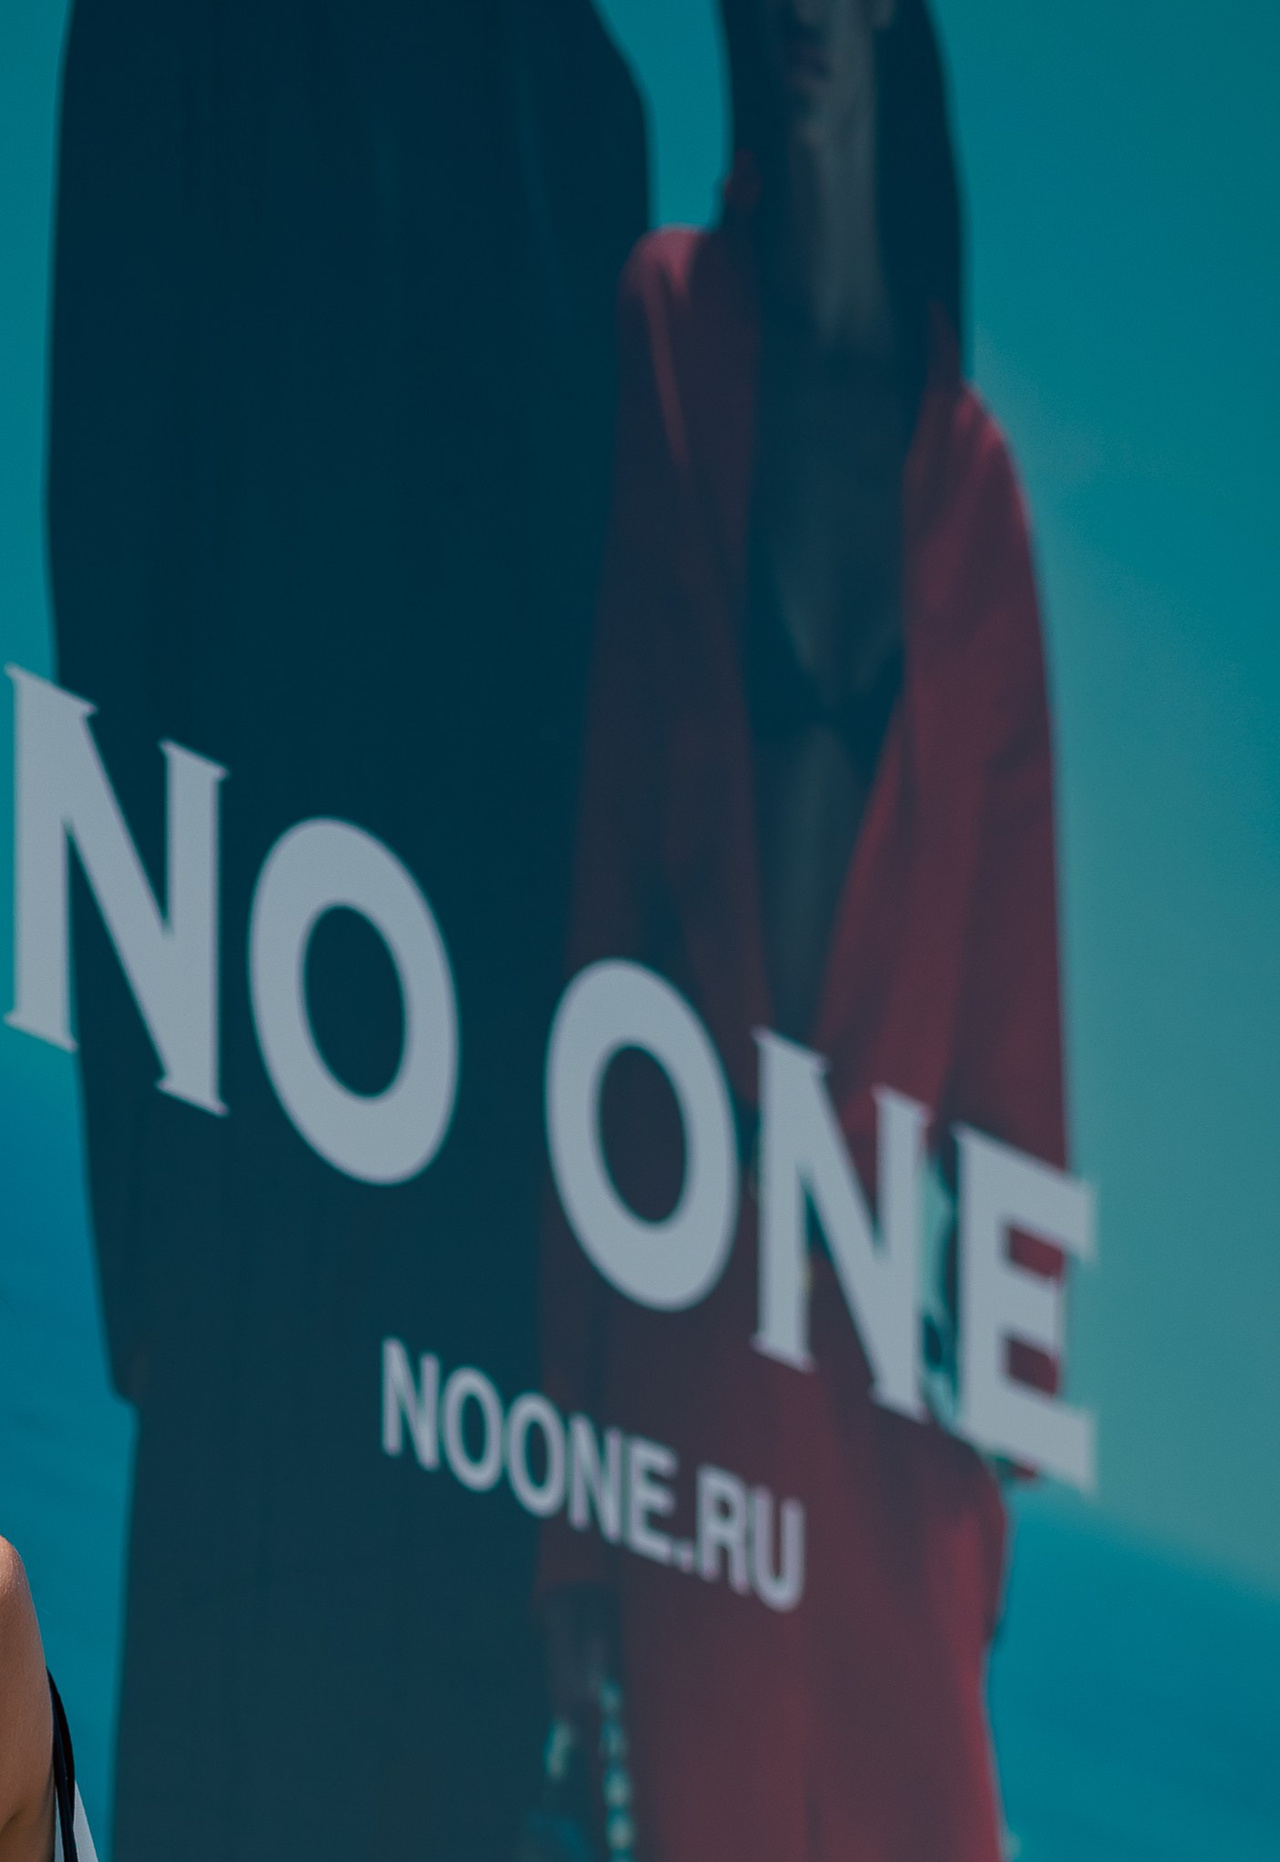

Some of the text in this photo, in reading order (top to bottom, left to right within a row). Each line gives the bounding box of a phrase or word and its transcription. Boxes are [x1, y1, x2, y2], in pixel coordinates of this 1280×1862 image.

[5, 664, 1099, 1492] NO ONE
[381, 1336, 807, 1611] NOONE.RU
